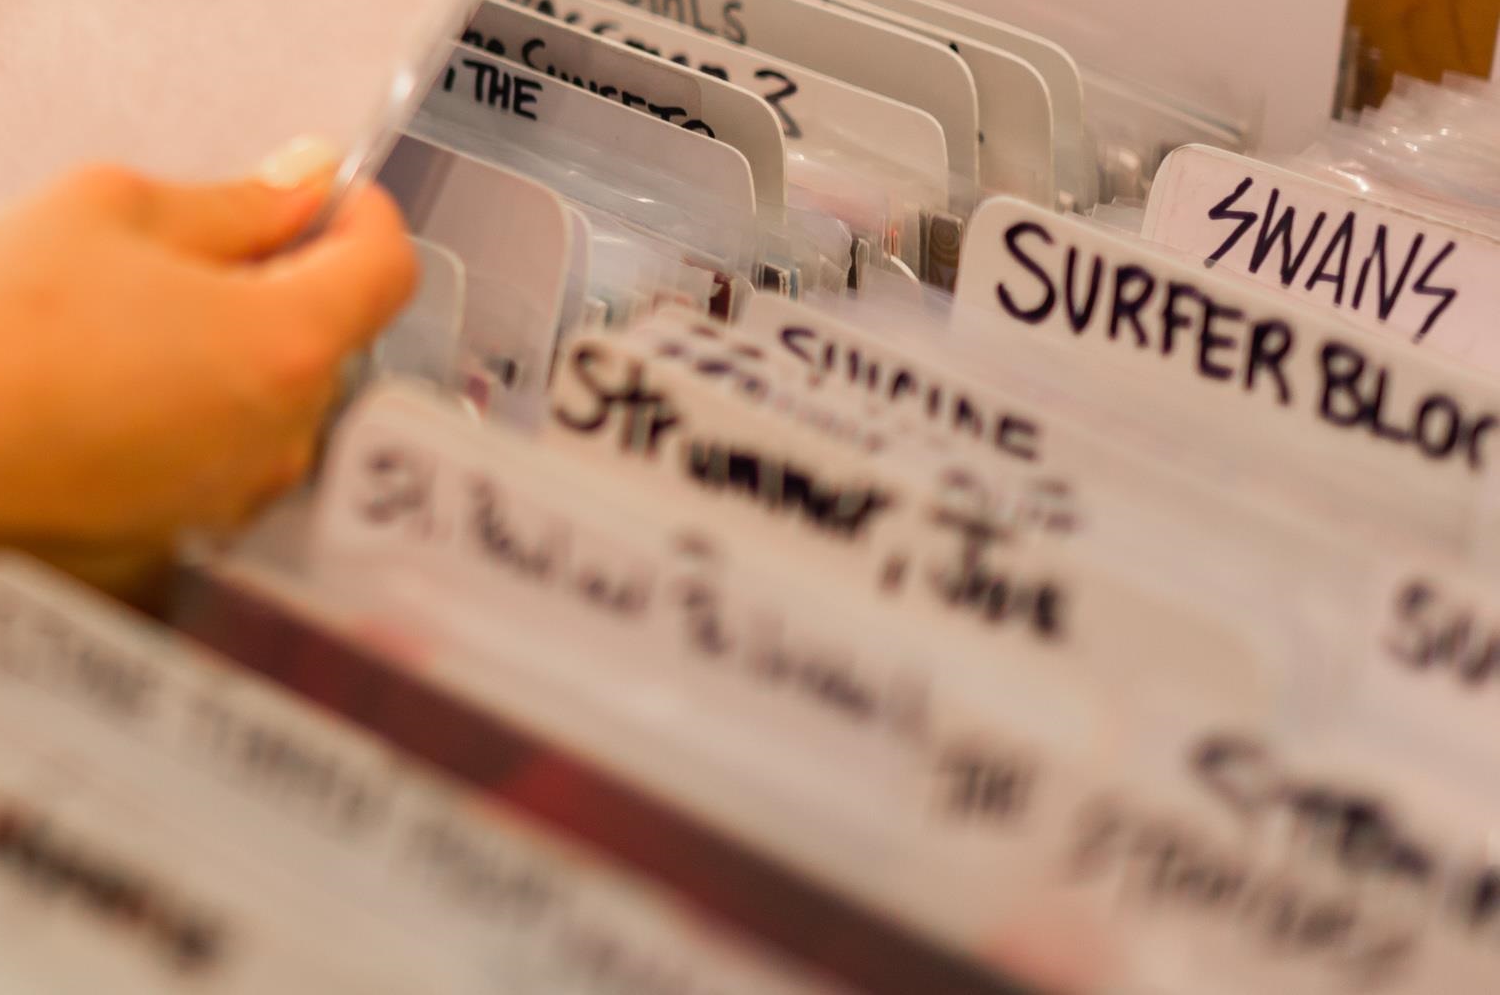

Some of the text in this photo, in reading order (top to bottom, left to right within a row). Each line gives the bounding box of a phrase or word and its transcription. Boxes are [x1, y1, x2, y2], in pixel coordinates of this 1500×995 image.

[462, 59, 543, 122] THE
[996, 220, 1292, 406] SURFER
[1202, 176, 1458, 344] SWANS
